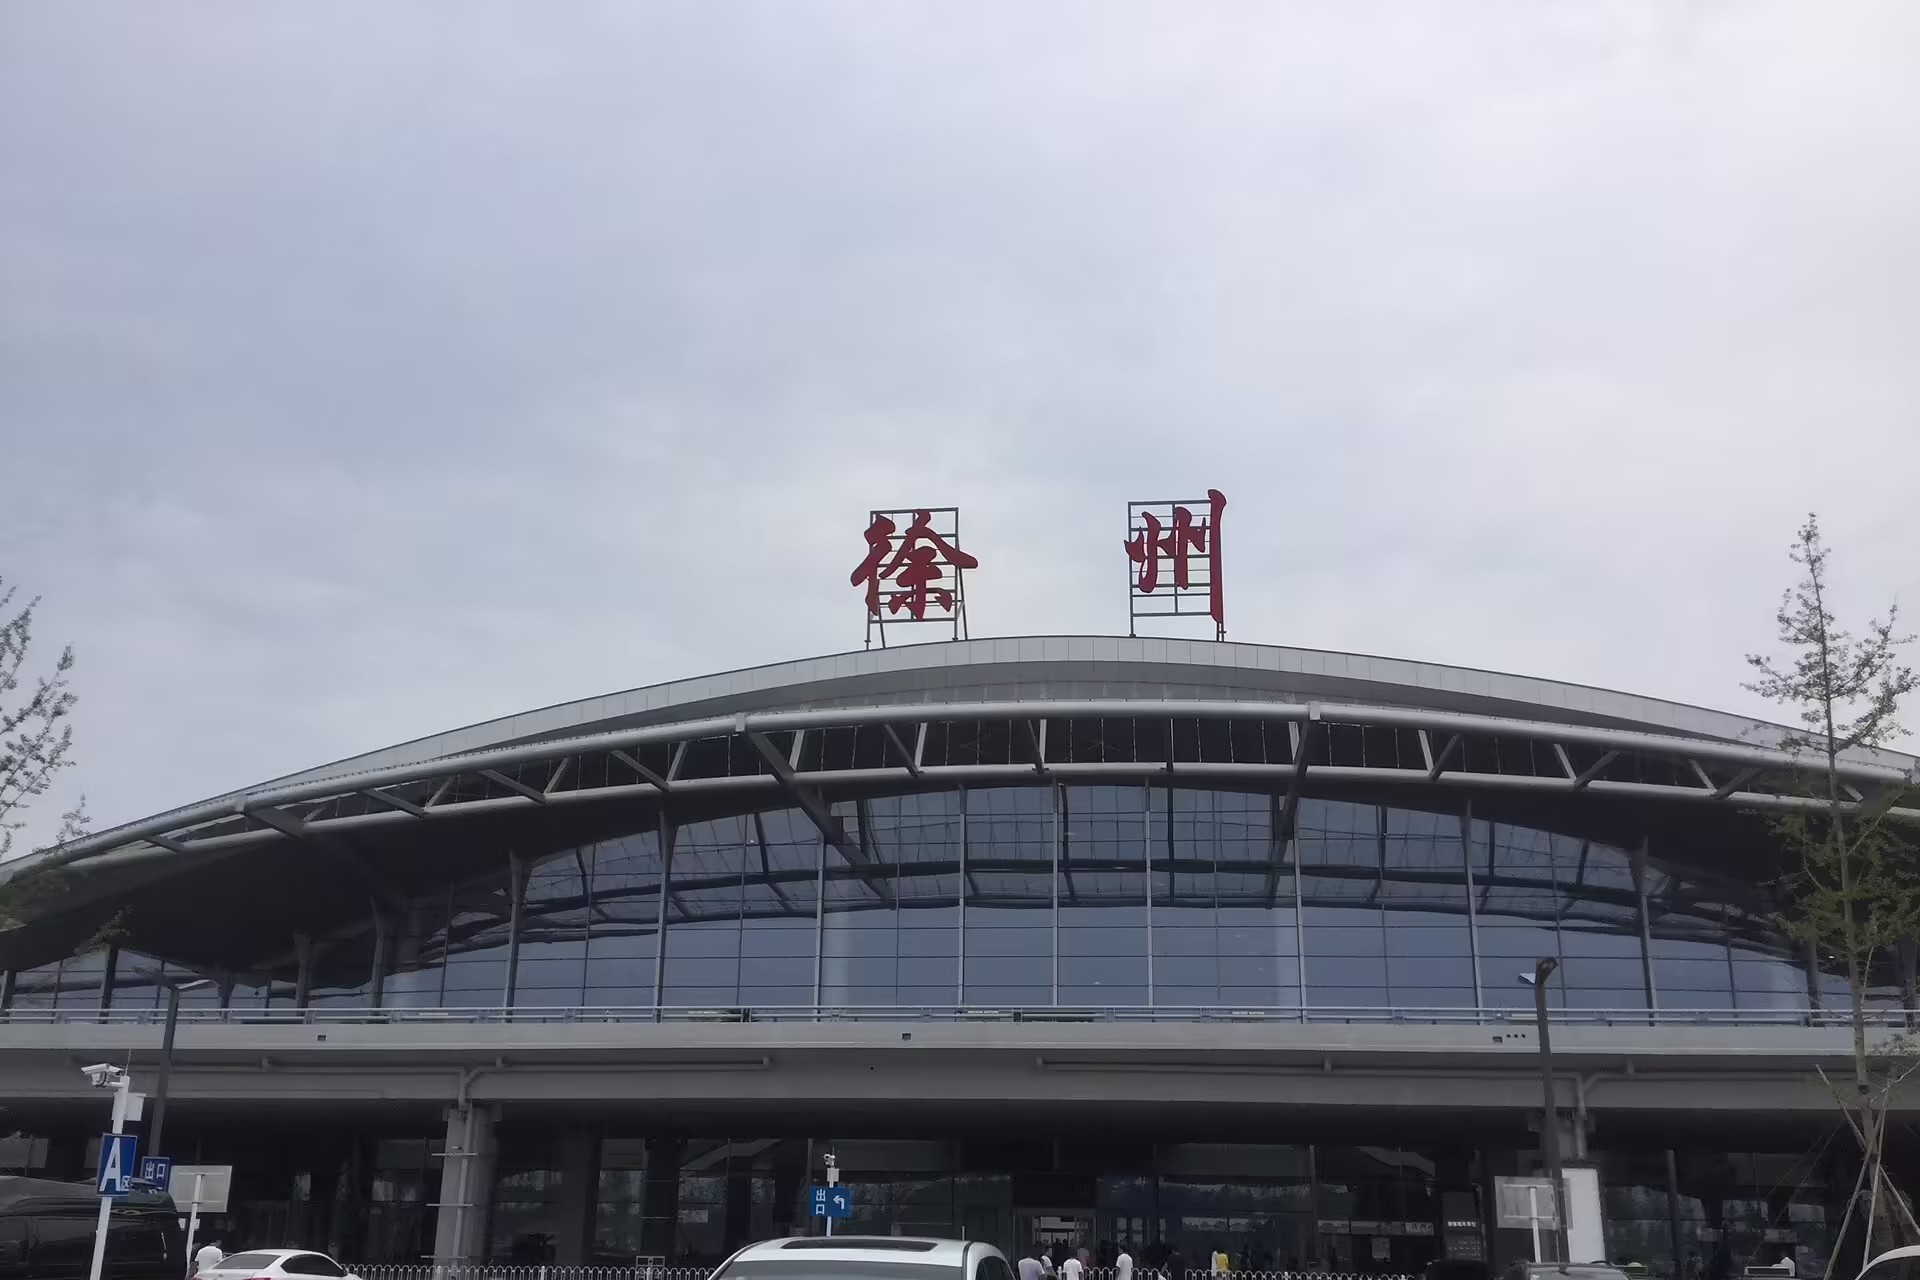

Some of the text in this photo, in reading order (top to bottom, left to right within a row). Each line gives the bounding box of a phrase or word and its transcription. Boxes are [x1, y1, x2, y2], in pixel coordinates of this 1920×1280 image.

[850, 489, 1227, 624] 徐州
[144, 1161, 166, 1180] 出口
[815, 1188, 826, 1215] 出口
